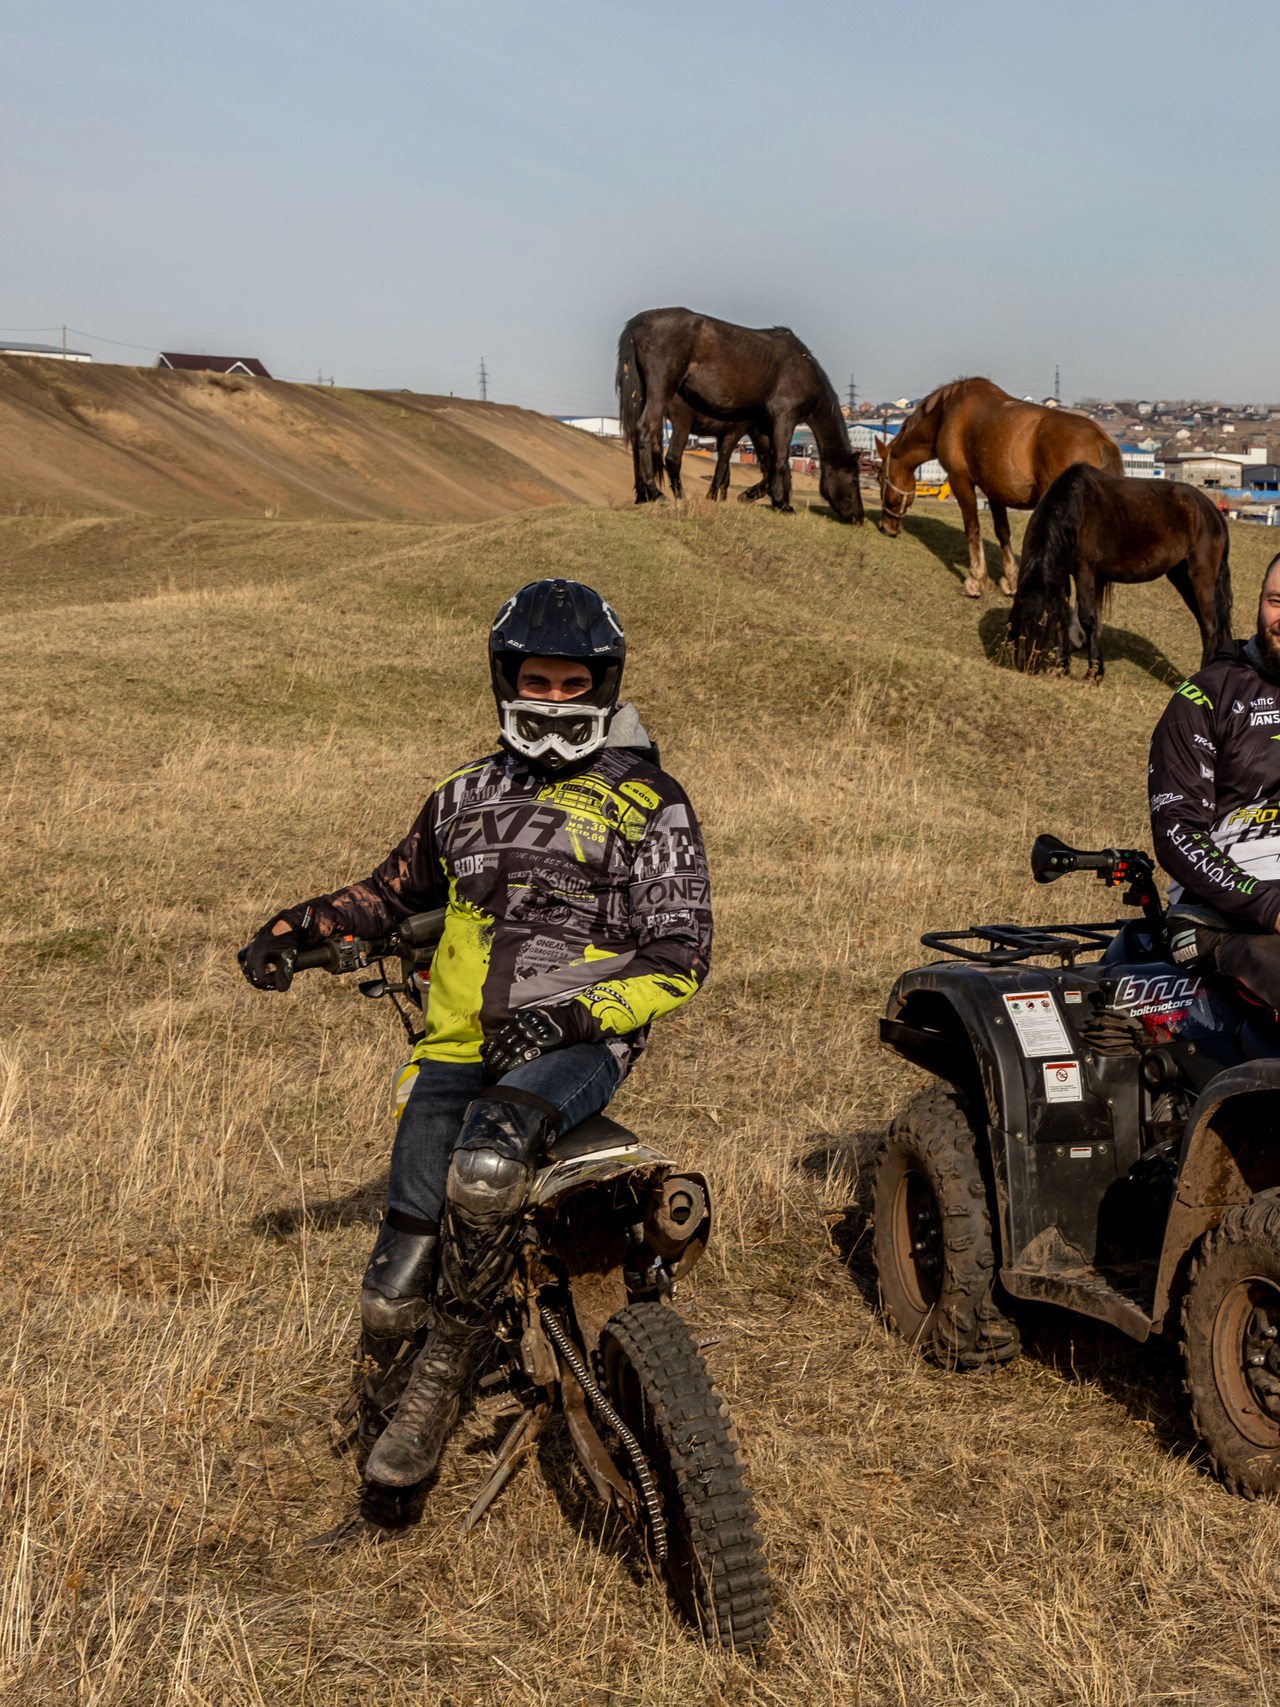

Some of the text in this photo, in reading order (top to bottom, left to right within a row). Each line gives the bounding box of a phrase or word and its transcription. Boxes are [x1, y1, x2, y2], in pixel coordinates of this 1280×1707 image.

[1250, 710, 1280, 726] VANS
[1228, 808, 1278, 826] PRO
[449, 804, 568, 852] FXR
[536, 939, 565, 951] ONEAL
